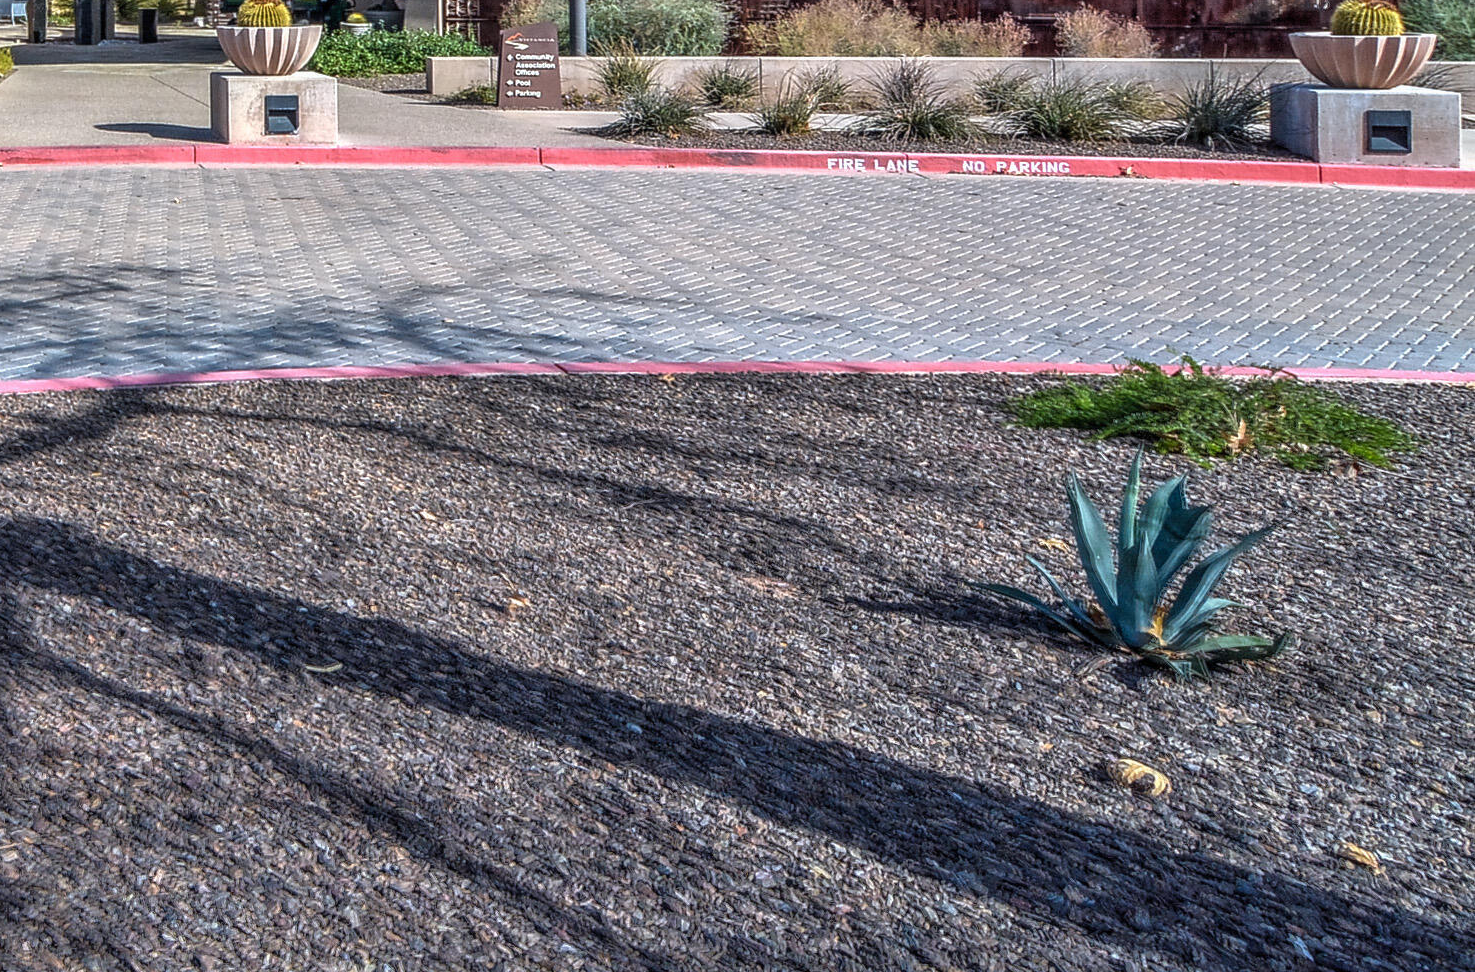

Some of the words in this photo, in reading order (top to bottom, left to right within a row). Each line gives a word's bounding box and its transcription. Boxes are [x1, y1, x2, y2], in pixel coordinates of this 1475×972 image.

[515, 53, 554, 62] Community
[515, 79, 531, 87] Pool
[515, 89, 541, 98] Parking
[827, 158, 866, 171] FIRE
[874, 159, 919, 172] LANE
[962, 160, 985, 172] NO
[996, 161, 1070, 173] PARKING
